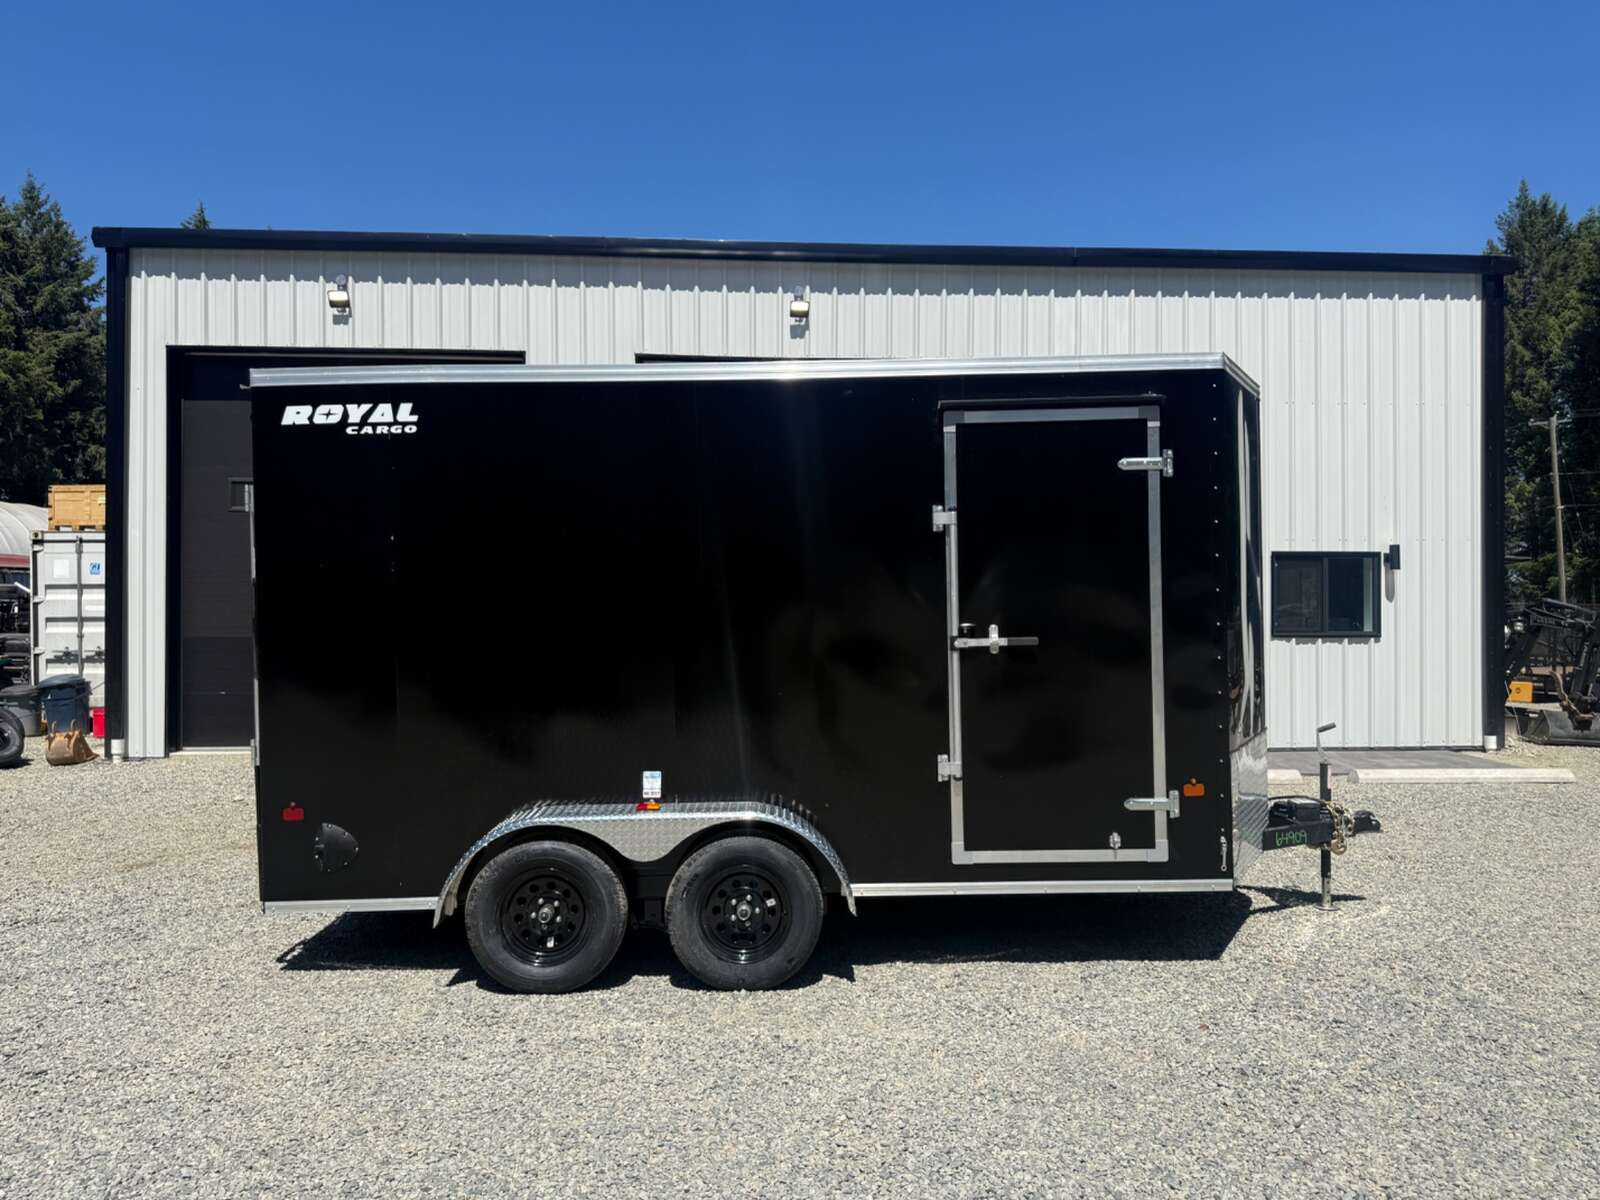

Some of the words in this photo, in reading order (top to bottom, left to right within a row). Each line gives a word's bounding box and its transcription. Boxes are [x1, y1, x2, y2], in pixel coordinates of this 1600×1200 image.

[281, 402, 419, 425] ROYAL
[345, 425, 418, 435] CARGO
[1275, 831, 1308, 847] 64909
